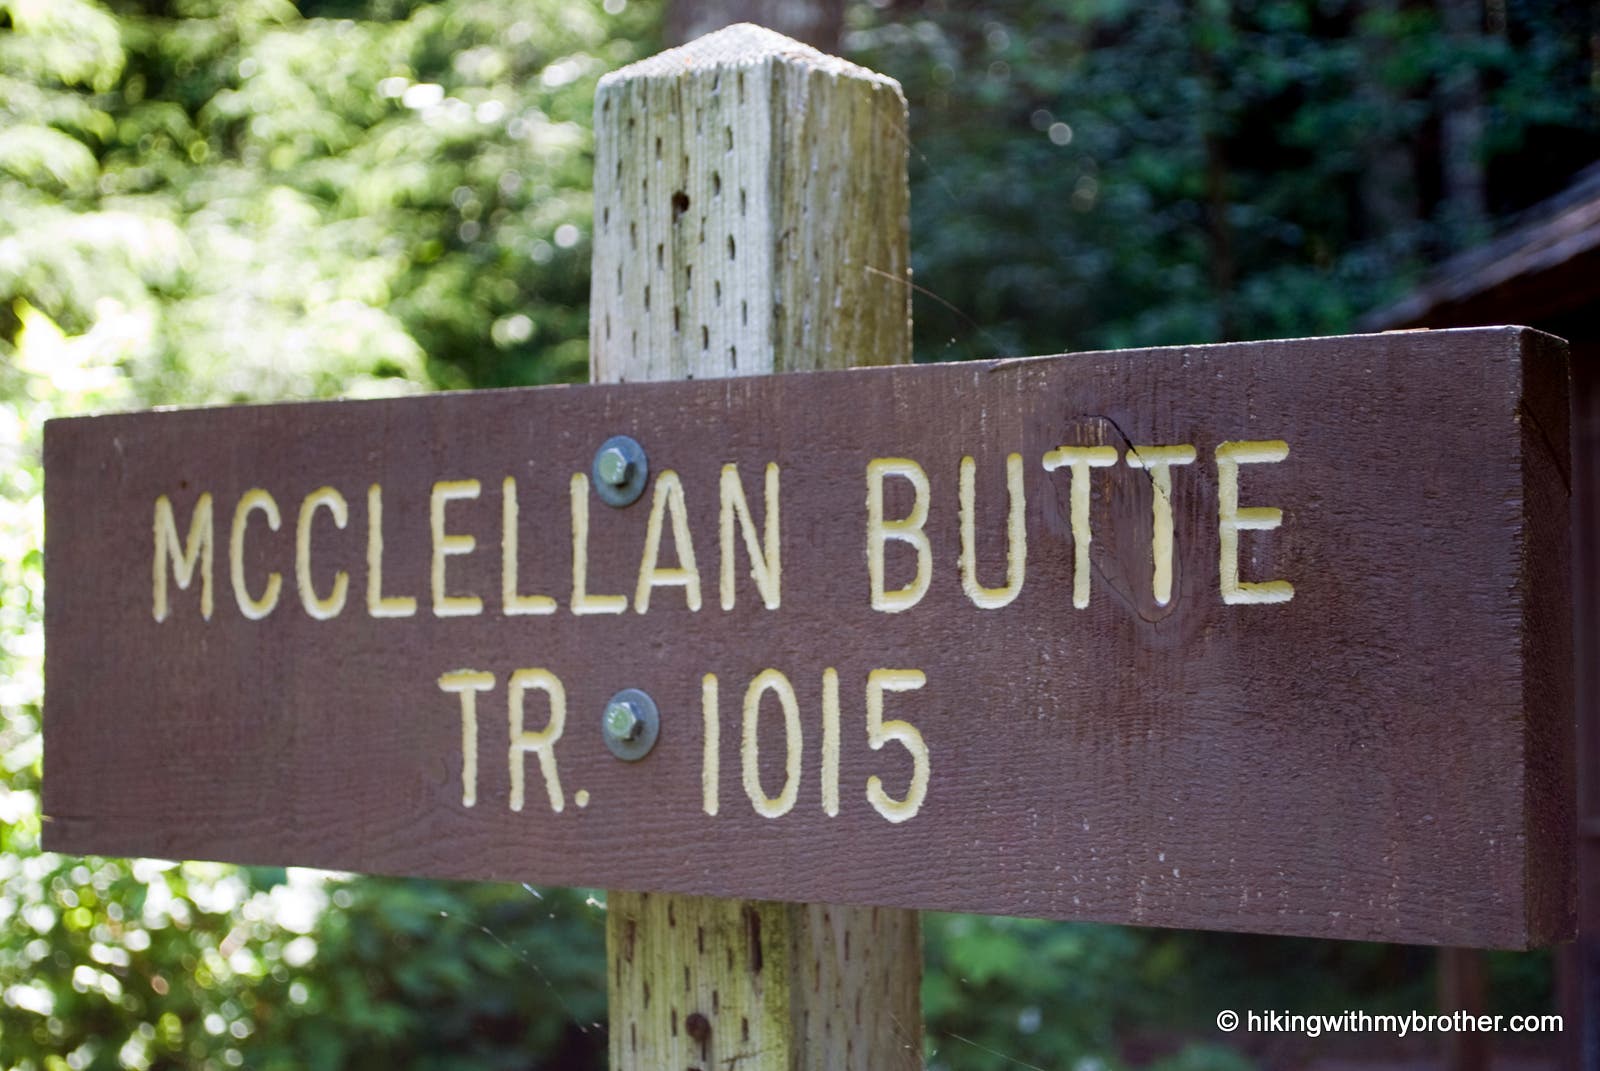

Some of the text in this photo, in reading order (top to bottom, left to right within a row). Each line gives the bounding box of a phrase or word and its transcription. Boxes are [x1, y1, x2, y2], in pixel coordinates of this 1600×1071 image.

[151, 440, 1295, 622] MCCLELLAN BUTTE
[438, 667, 931, 824] TR. 1015
